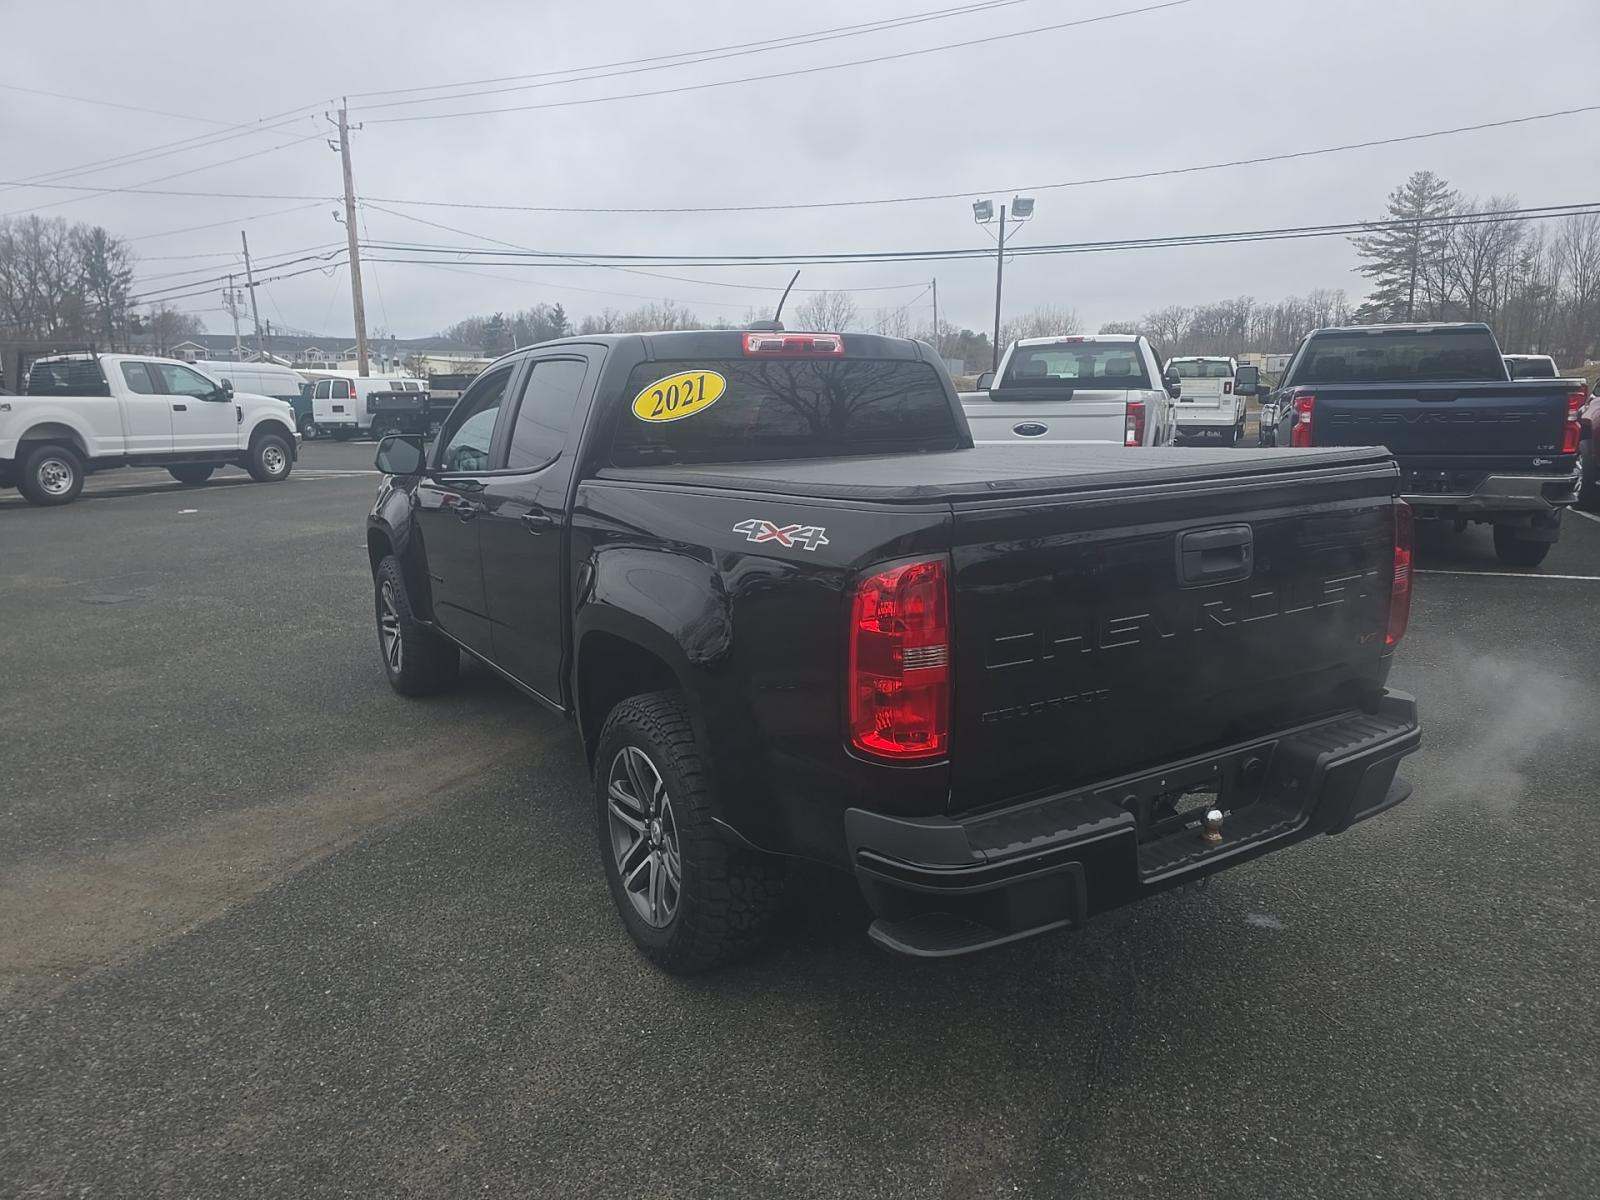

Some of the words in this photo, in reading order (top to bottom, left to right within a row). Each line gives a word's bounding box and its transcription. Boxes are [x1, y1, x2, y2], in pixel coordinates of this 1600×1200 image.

[650, 374, 706, 418] 2021
[1330, 411, 1548, 425] CHEVROLET
[985, 570, 1380, 669] CHEVROLET
